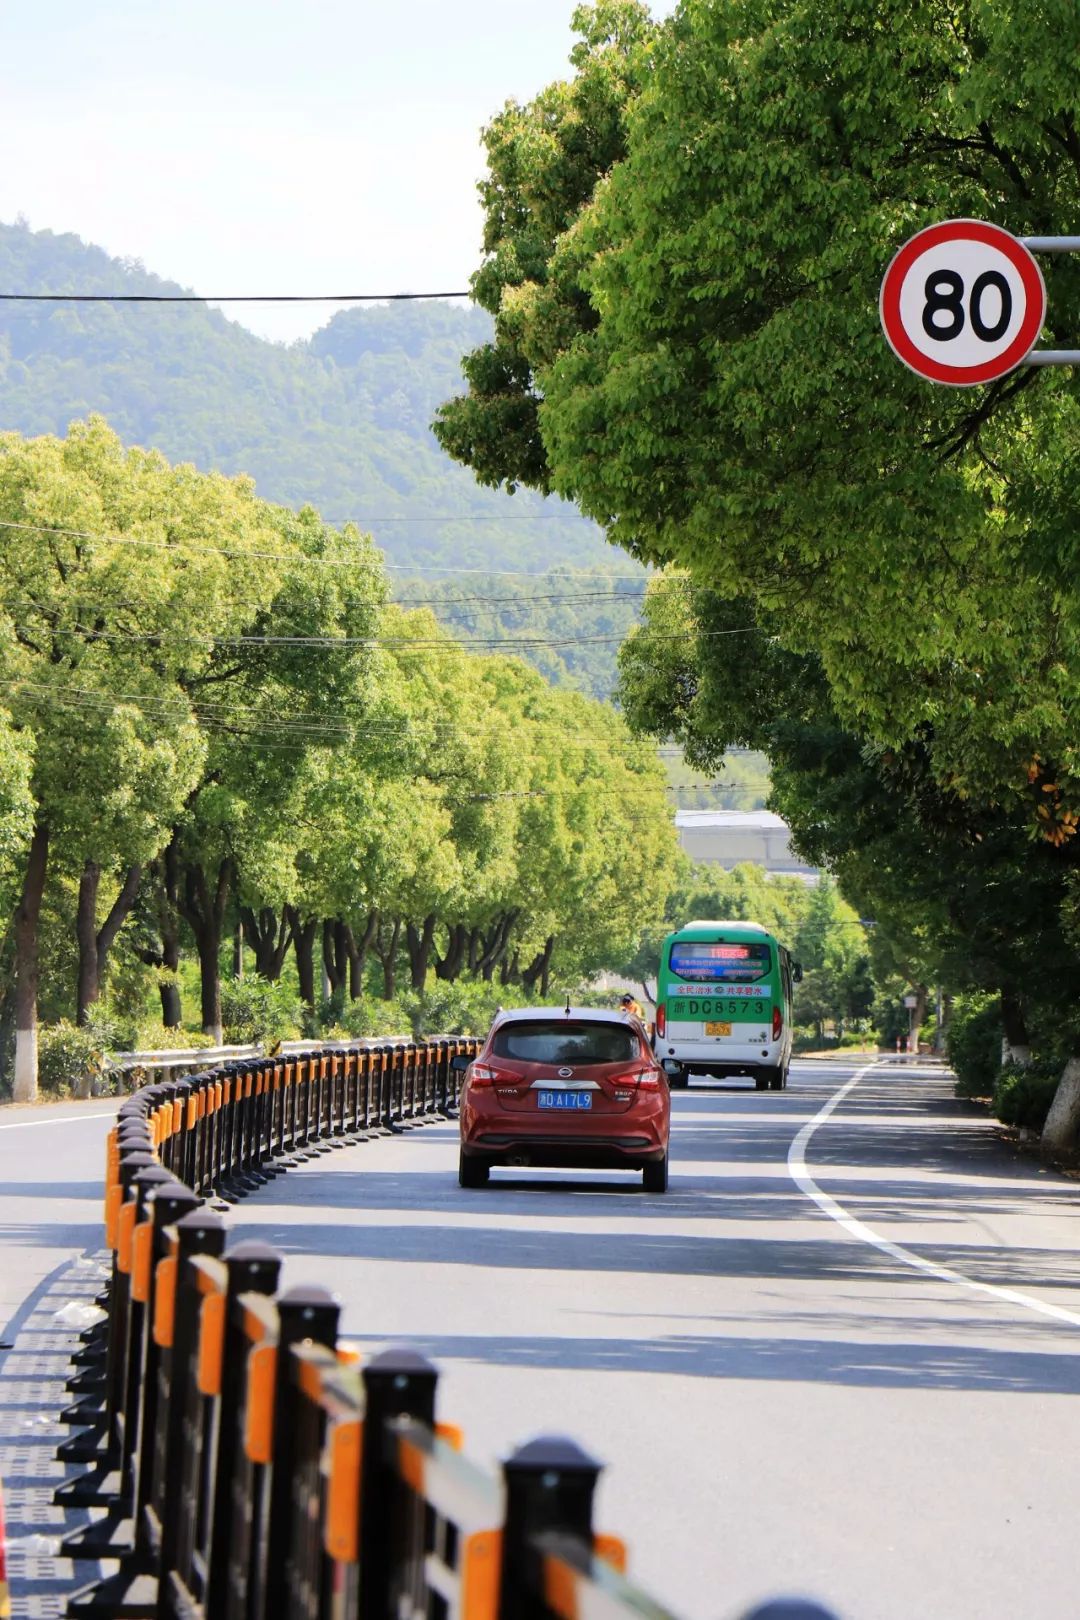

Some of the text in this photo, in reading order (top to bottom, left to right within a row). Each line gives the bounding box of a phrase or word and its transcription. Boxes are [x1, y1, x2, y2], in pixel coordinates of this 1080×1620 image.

[922, 269, 1012, 342] 80
[678, 985, 763, 996] 全民治水 共享碧水
